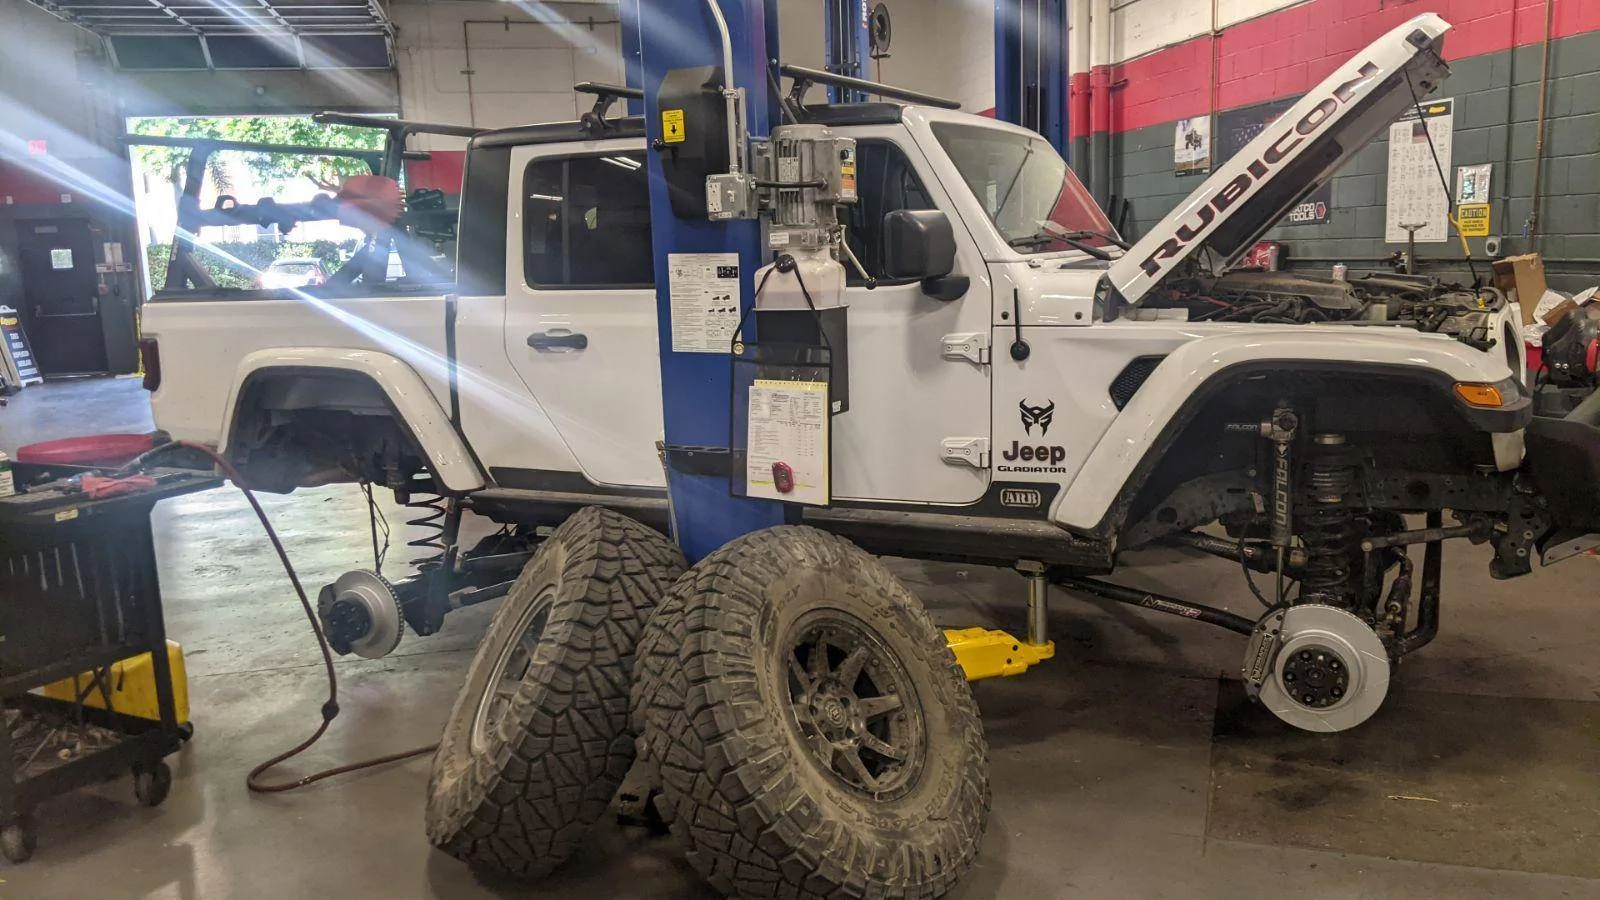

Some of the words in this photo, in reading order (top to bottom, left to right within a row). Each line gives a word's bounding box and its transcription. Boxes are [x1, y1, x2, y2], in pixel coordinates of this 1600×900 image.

[1139, 61, 1379, 277] RUBICON
[1290, 212, 1315, 221] TOOLS
[1461, 208, 1488, 217] CAUTION
[1002, 440, 1066, 465] Jeep
[997, 465, 1067, 473] GLADIATOR
[1004, 491, 1038, 504] ARB
[1276, 458, 1288, 525] FALCON
